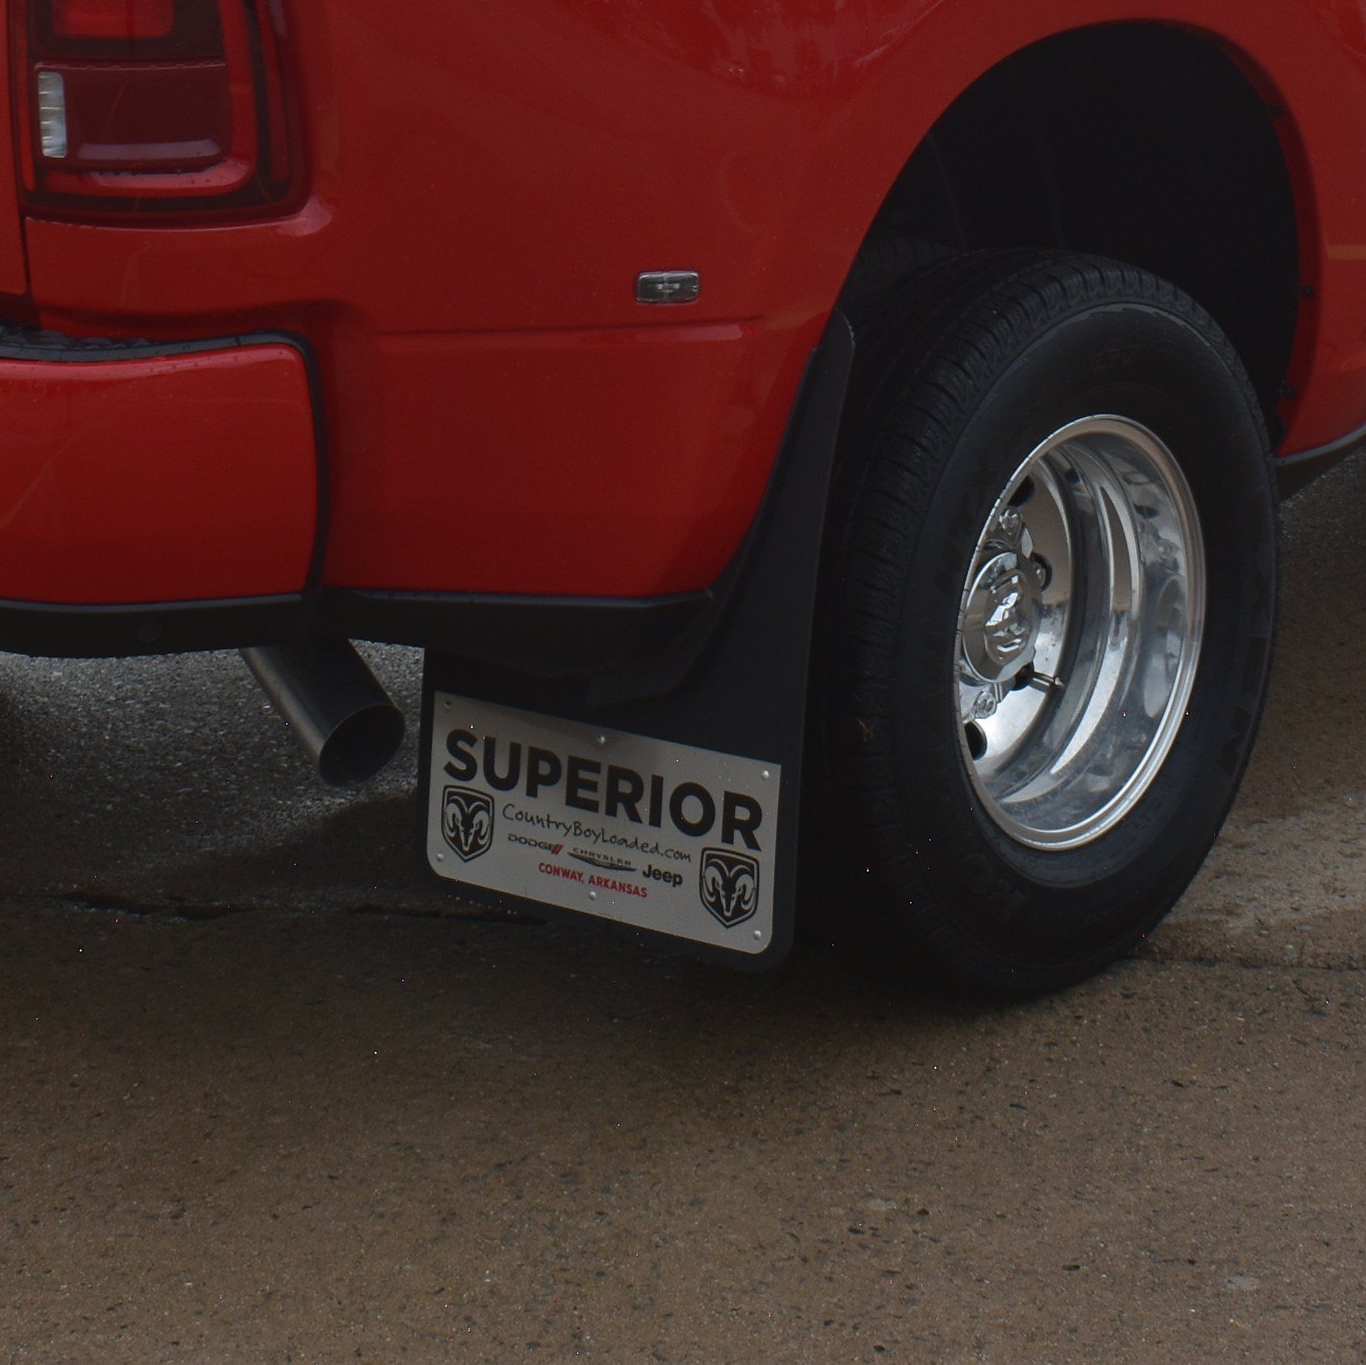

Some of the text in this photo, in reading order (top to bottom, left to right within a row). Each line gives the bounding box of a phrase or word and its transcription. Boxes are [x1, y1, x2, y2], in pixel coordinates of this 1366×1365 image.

[443, 727, 763, 852] SUPERIOR
[502, 802, 692, 863] CountryBoyLoaded.com
[507, 833, 683, 887] DODGE CHRYSLER Jeep
[538, 862, 649, 899] CONWAY, ARKANSAS
